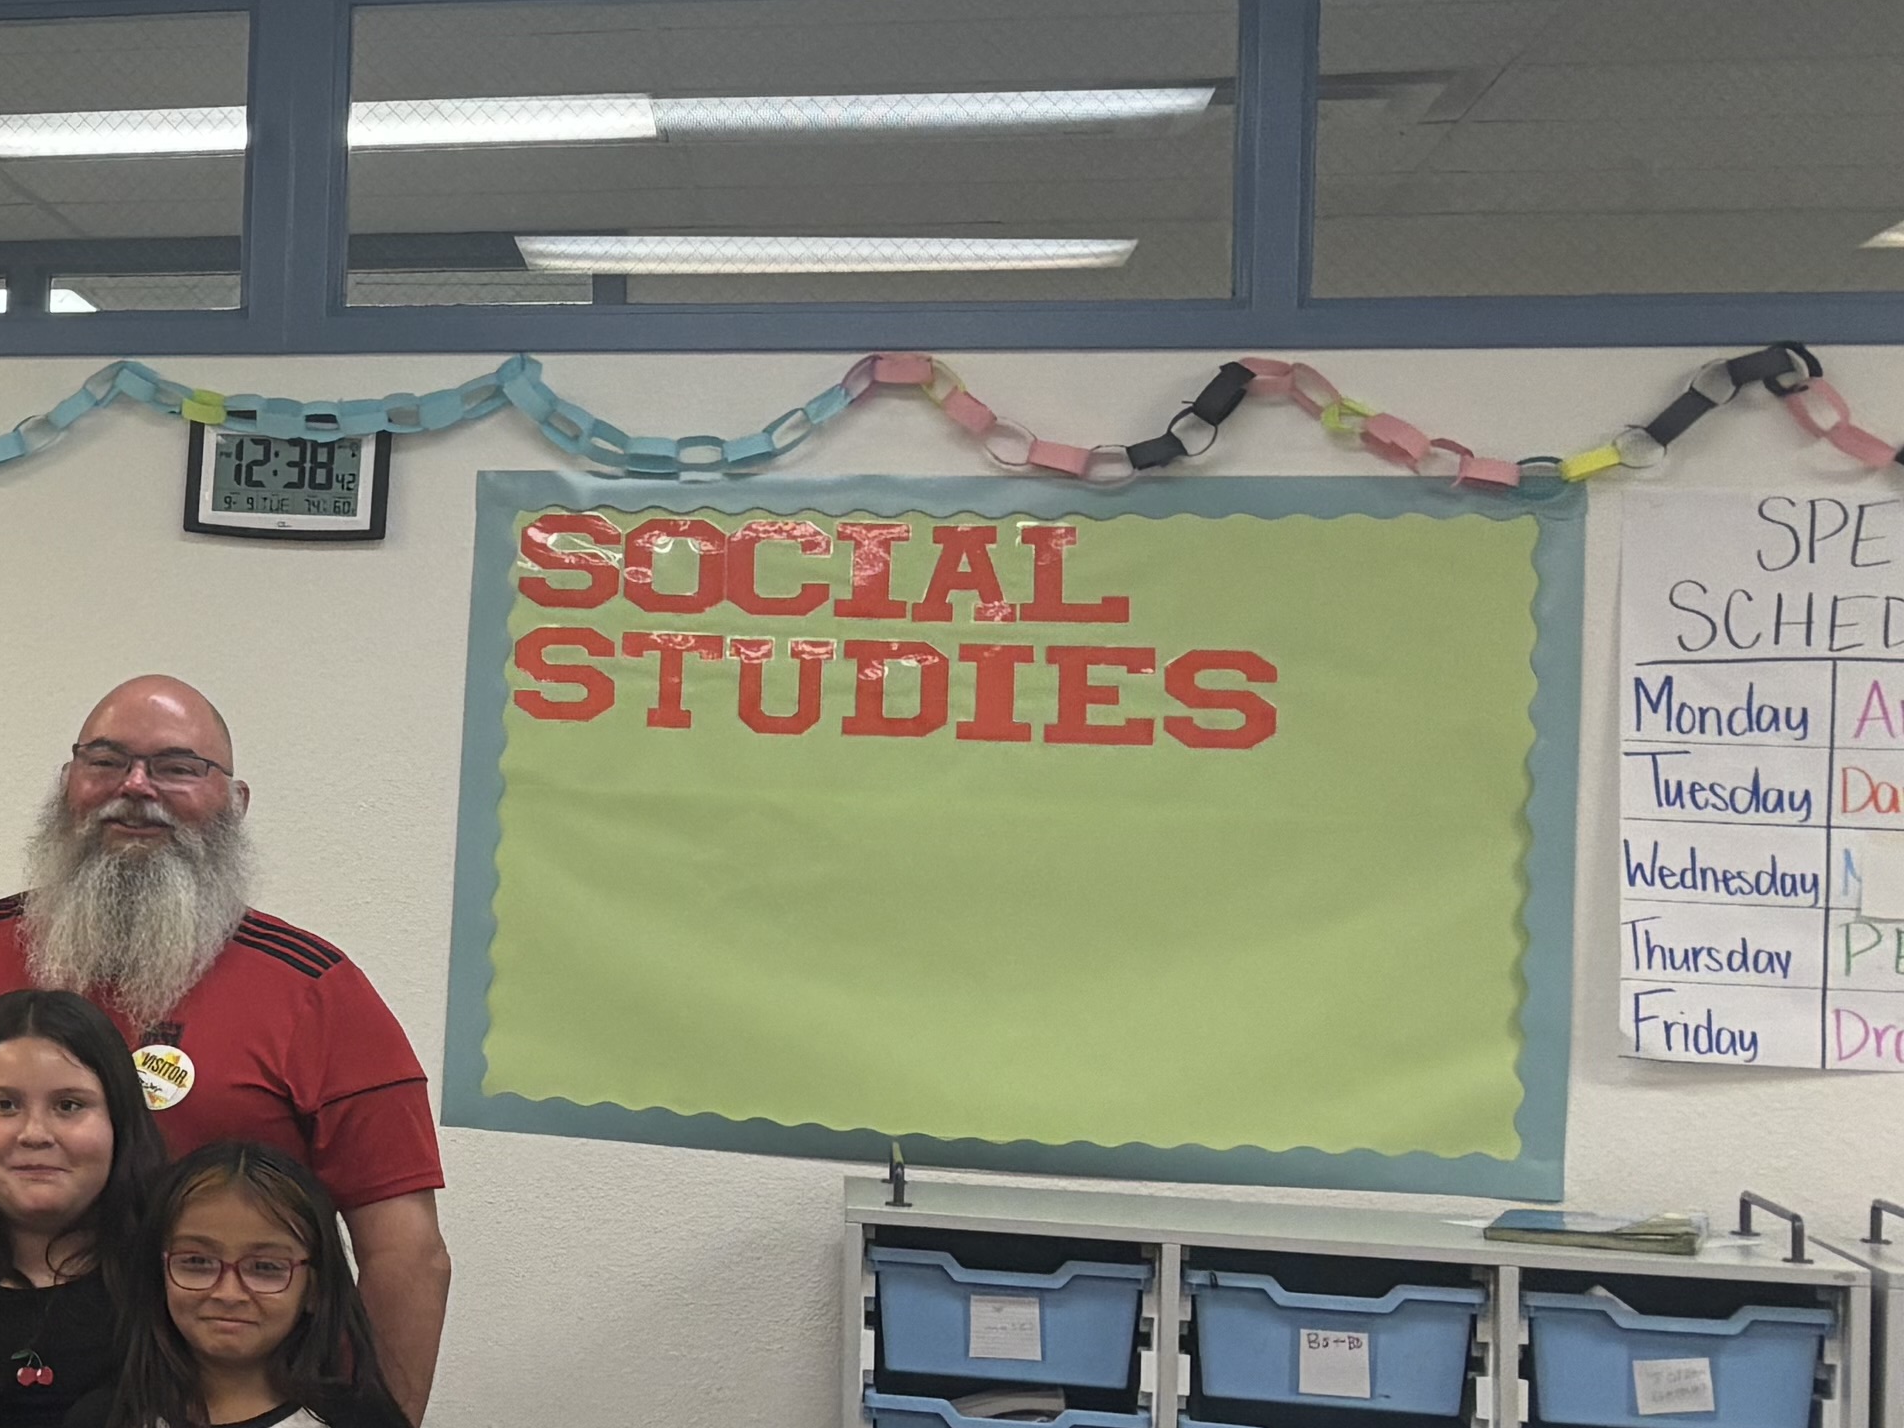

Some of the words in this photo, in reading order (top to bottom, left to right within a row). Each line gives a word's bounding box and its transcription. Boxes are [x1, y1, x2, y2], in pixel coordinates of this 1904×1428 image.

[234, 436, 335, 490] 12:38
[335, 473, 356, 491] 42
[262, 497, 290, 513] TUE
[1756, 496, 1901, 571] SPE
[517, 511, 1130, 624] SOCIAL
[513, 625, 1278, 750] STUDIES
[1633, 676, 1809, 741] Monday
[1623, 750, 1812, 822] Tuesday
[1623, 838, 1820, 907] Wednesday
[1623, 916, 1792, 979] Thursday
[1633, 988, 1759, 1060] Friday
[142, 1052, 188, 1085] VISITOR
